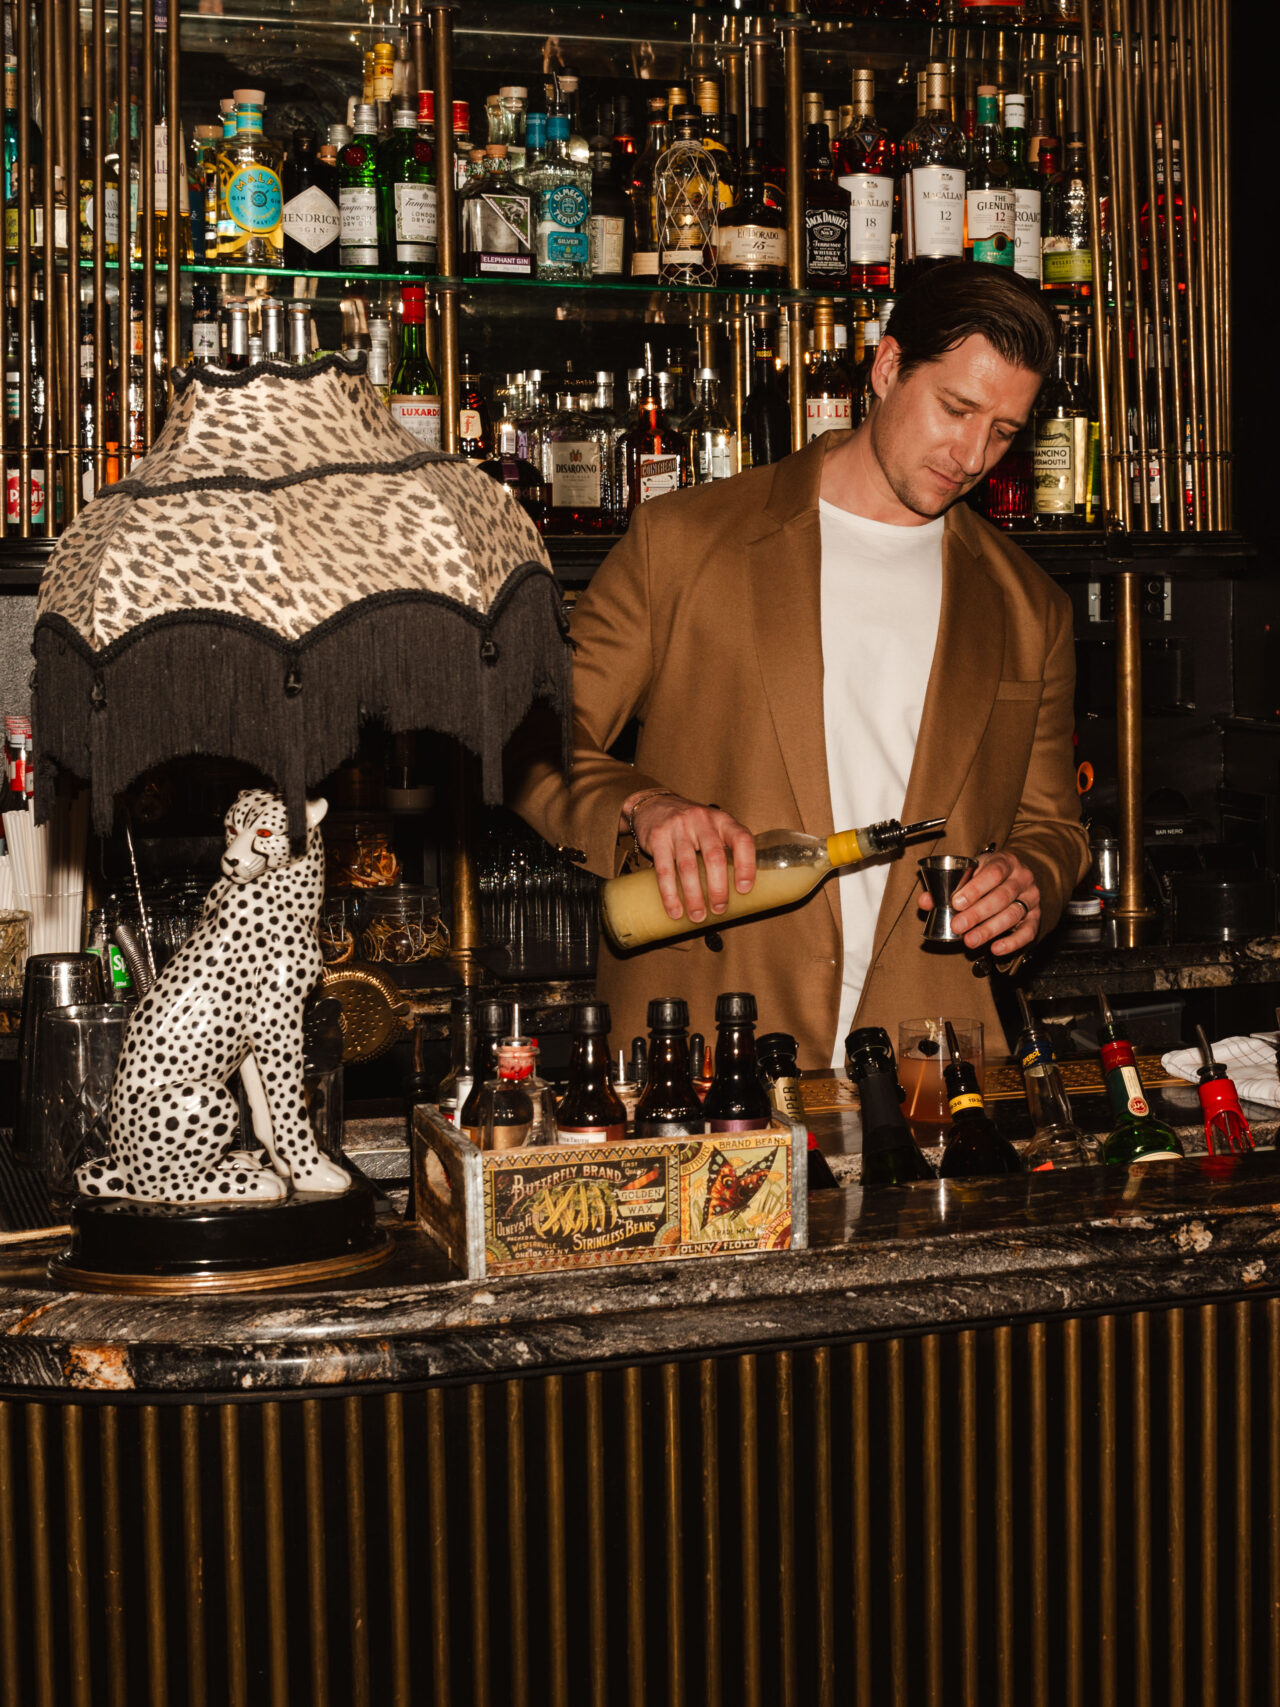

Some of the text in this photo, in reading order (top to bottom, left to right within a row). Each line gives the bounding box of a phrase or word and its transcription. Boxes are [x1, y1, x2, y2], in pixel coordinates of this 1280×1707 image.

[235, 173, 280, 192] MALFY
[554, 189, 583, 203] OLMECA
[553, 210, 584, 225] TEQUILA
[805, 215, 823, 229] JACK
[865, 217, 877, 228] 18
[940, 211, 952, 221] 12
[995, 212, 1006, 222] 12
[1015, 212, 1041, 224] ROAIG
[752, 241, 767, 250] 15
[483, 256, 515, 264] ELEPHANT
[807, 404, 850, 418] LILLE
[555, 464, 597, 474] DISARONNO
[681, 1137, 787, 1174] BUTTERFLY BRAND BEANS
[512, 1165, 622, 1200] BUTTERFLY BRAND
[621, 1188, 662, 1199] GOLDEN
[628, 1205, 652, 1214] WAX
[497, 1221, 519, 1237] OLNEY
[572, 1219, 656, 1251] STRINGLESS BEANS
[680, 1240, 757, 1254] OLNEY FLOYD
